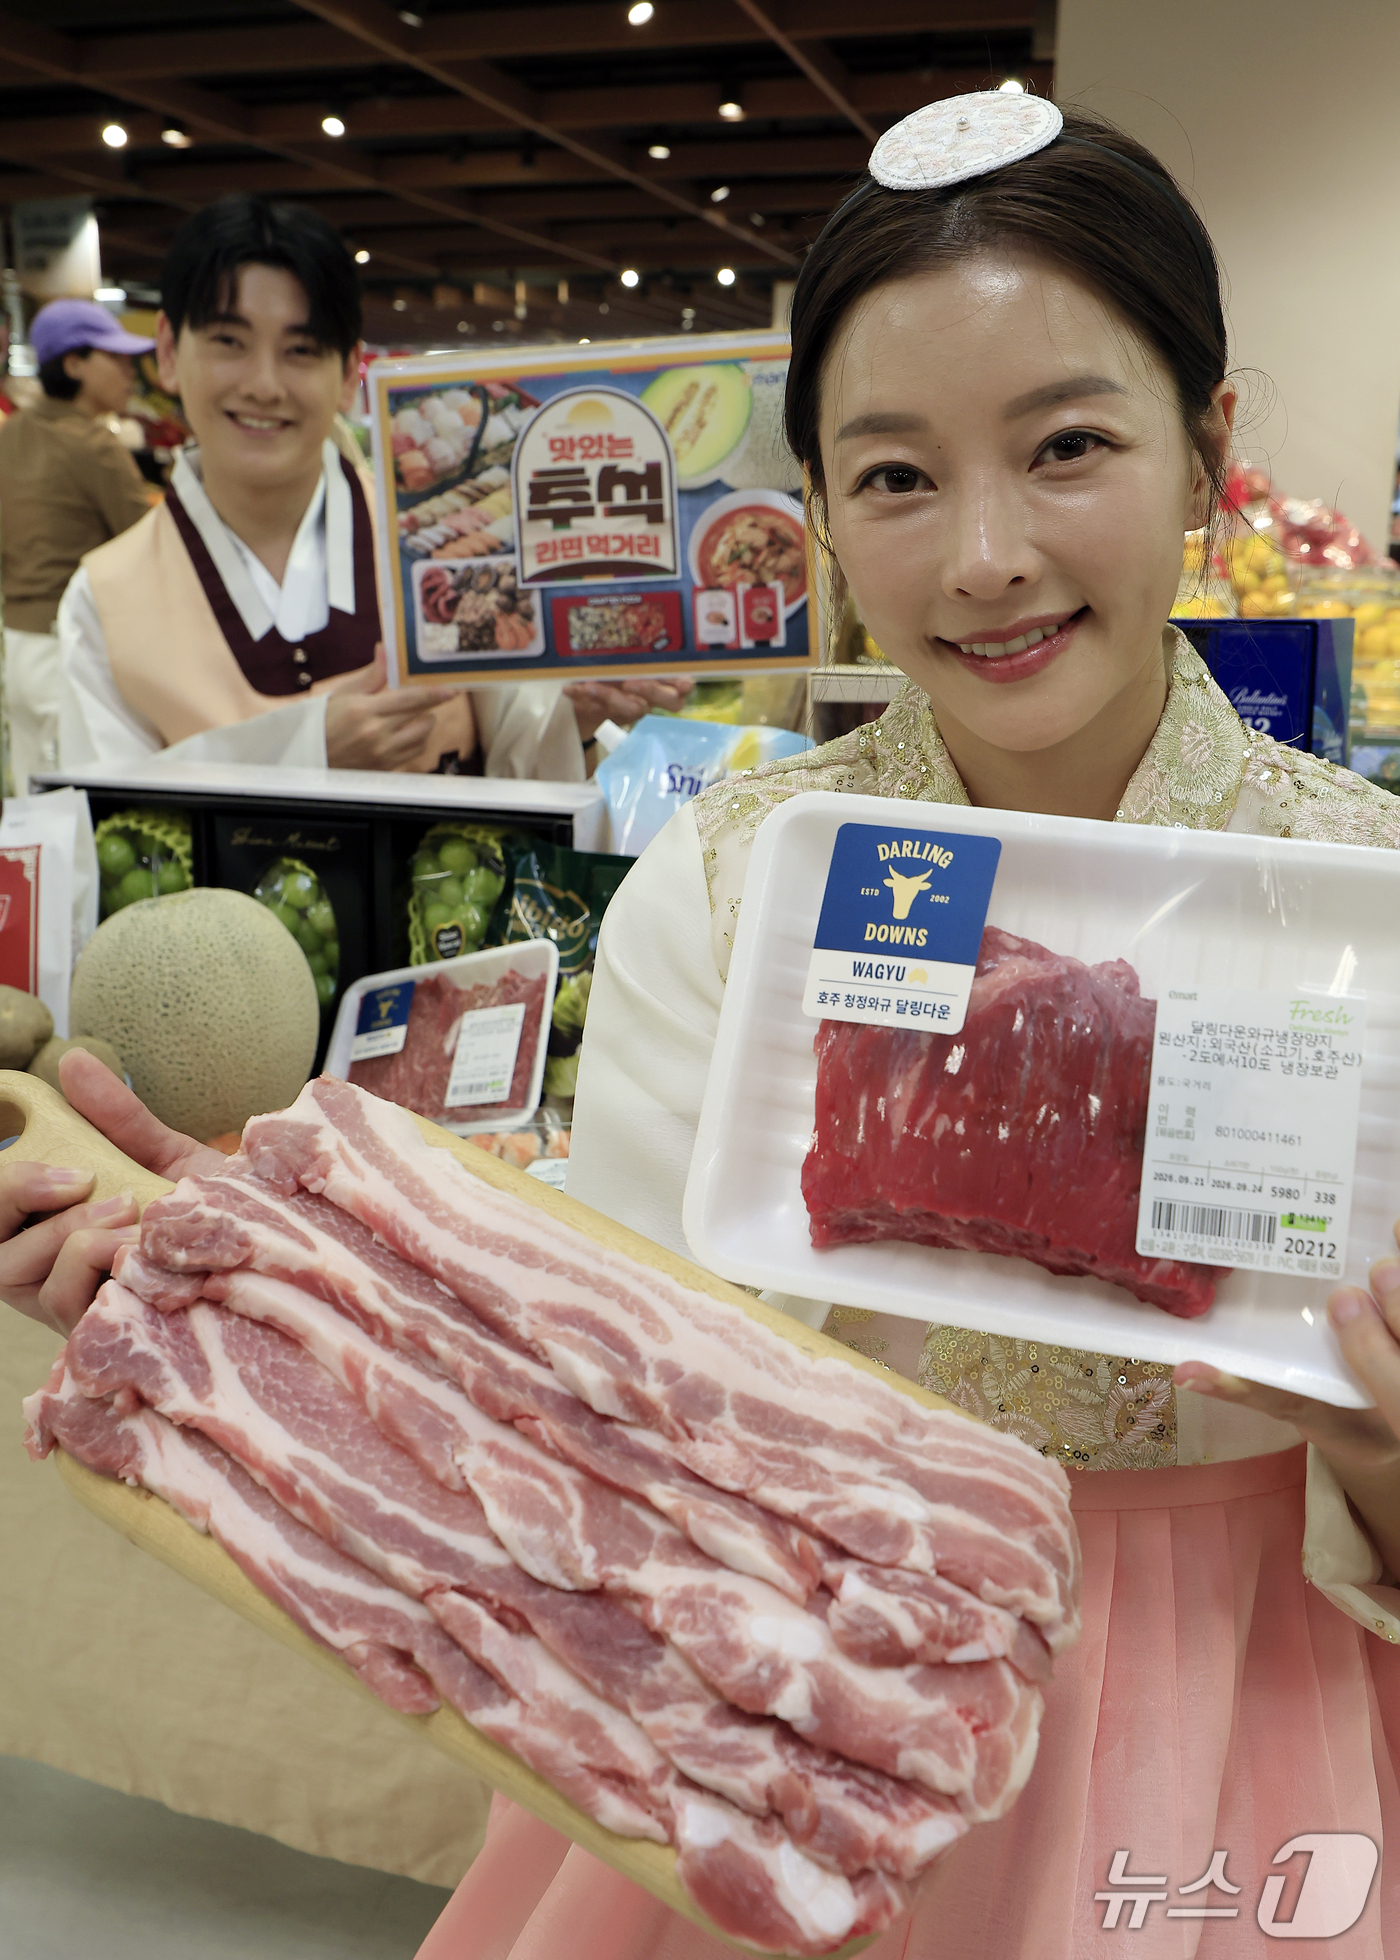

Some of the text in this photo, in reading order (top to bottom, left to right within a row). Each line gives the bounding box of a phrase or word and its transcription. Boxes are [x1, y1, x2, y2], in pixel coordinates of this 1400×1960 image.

[549, 434, 634, 463] 맛있는
[527, 462, 664, 530] 추석
[535, 533, 660, 565] 간편 먹거리
[877, 840, 954, 869] DARLING
[860, 887, 950, 904] ESTD 2002
[864, 922, 929, 947] DOWNS
[852, 960, 906, 982] WAGYU
[816, 991, 951, 1021] 호주 청정와규 달링다운
[1289, 1000, 1355, 1025] Fresh
[1280, 1060, 1339, 1080] 냉장보관
[1270, 1186, 1301, 1201] 5980
[1314, 1191, 1337, 1206] 338
[1284, 1237, 1337, 1259] 20212
